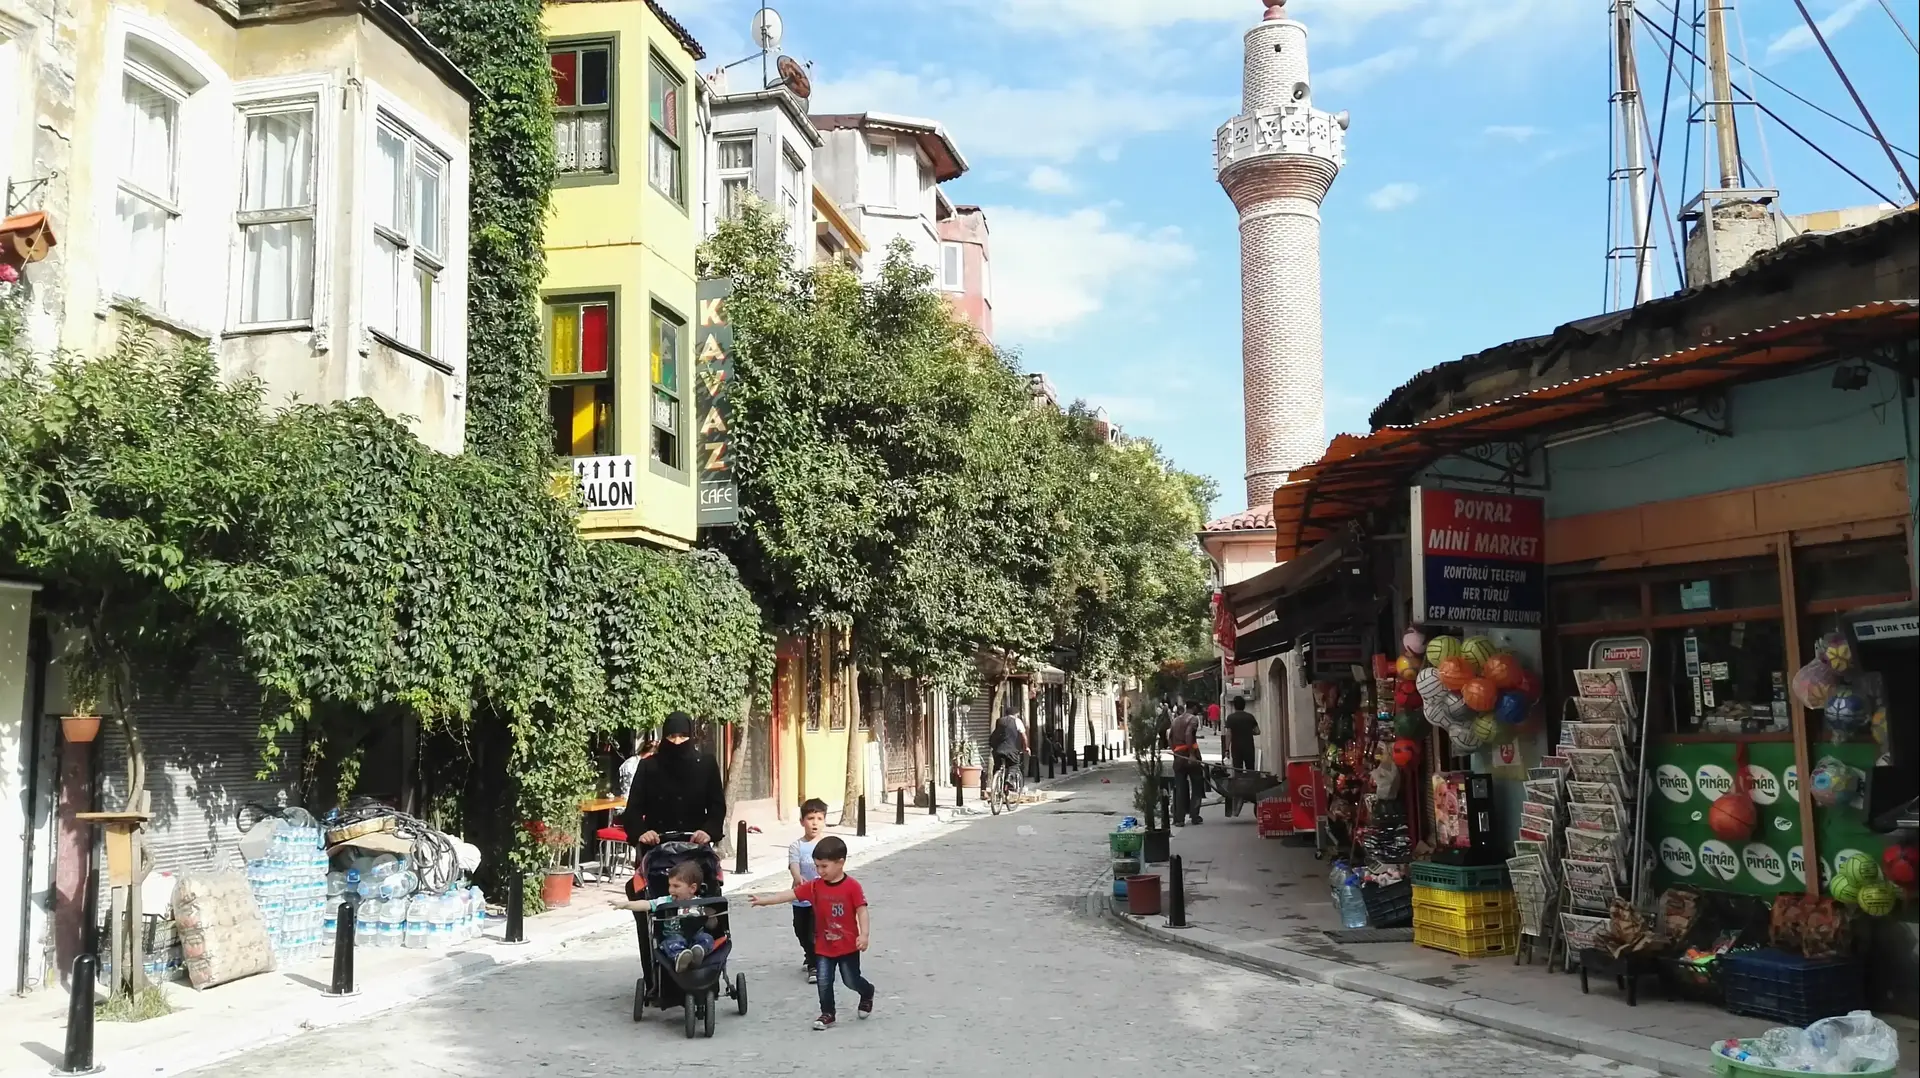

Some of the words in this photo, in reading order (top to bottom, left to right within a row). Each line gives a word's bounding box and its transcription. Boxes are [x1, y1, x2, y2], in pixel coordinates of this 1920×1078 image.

[700, 487, 733, 504] KAFE
[1454, 498, 1513, 523] POYRAZ
[1475, 532, 1538, 557] MARKET
[1443, 564, 1489, 582] KONTÖRLÜ
[1491, 569, 1526, 583] TELEFON
[1462, 586, 1481, 602] HER
[1482, 585, 1510, 602] TÜRLÜ
[1428, 605, 1446, 619] CEP
[1502, 609, 1542, 624] BULUNUR
[1603, 648, 1641, 661] Hürriyet
[832, 903, 844, 916] 58
